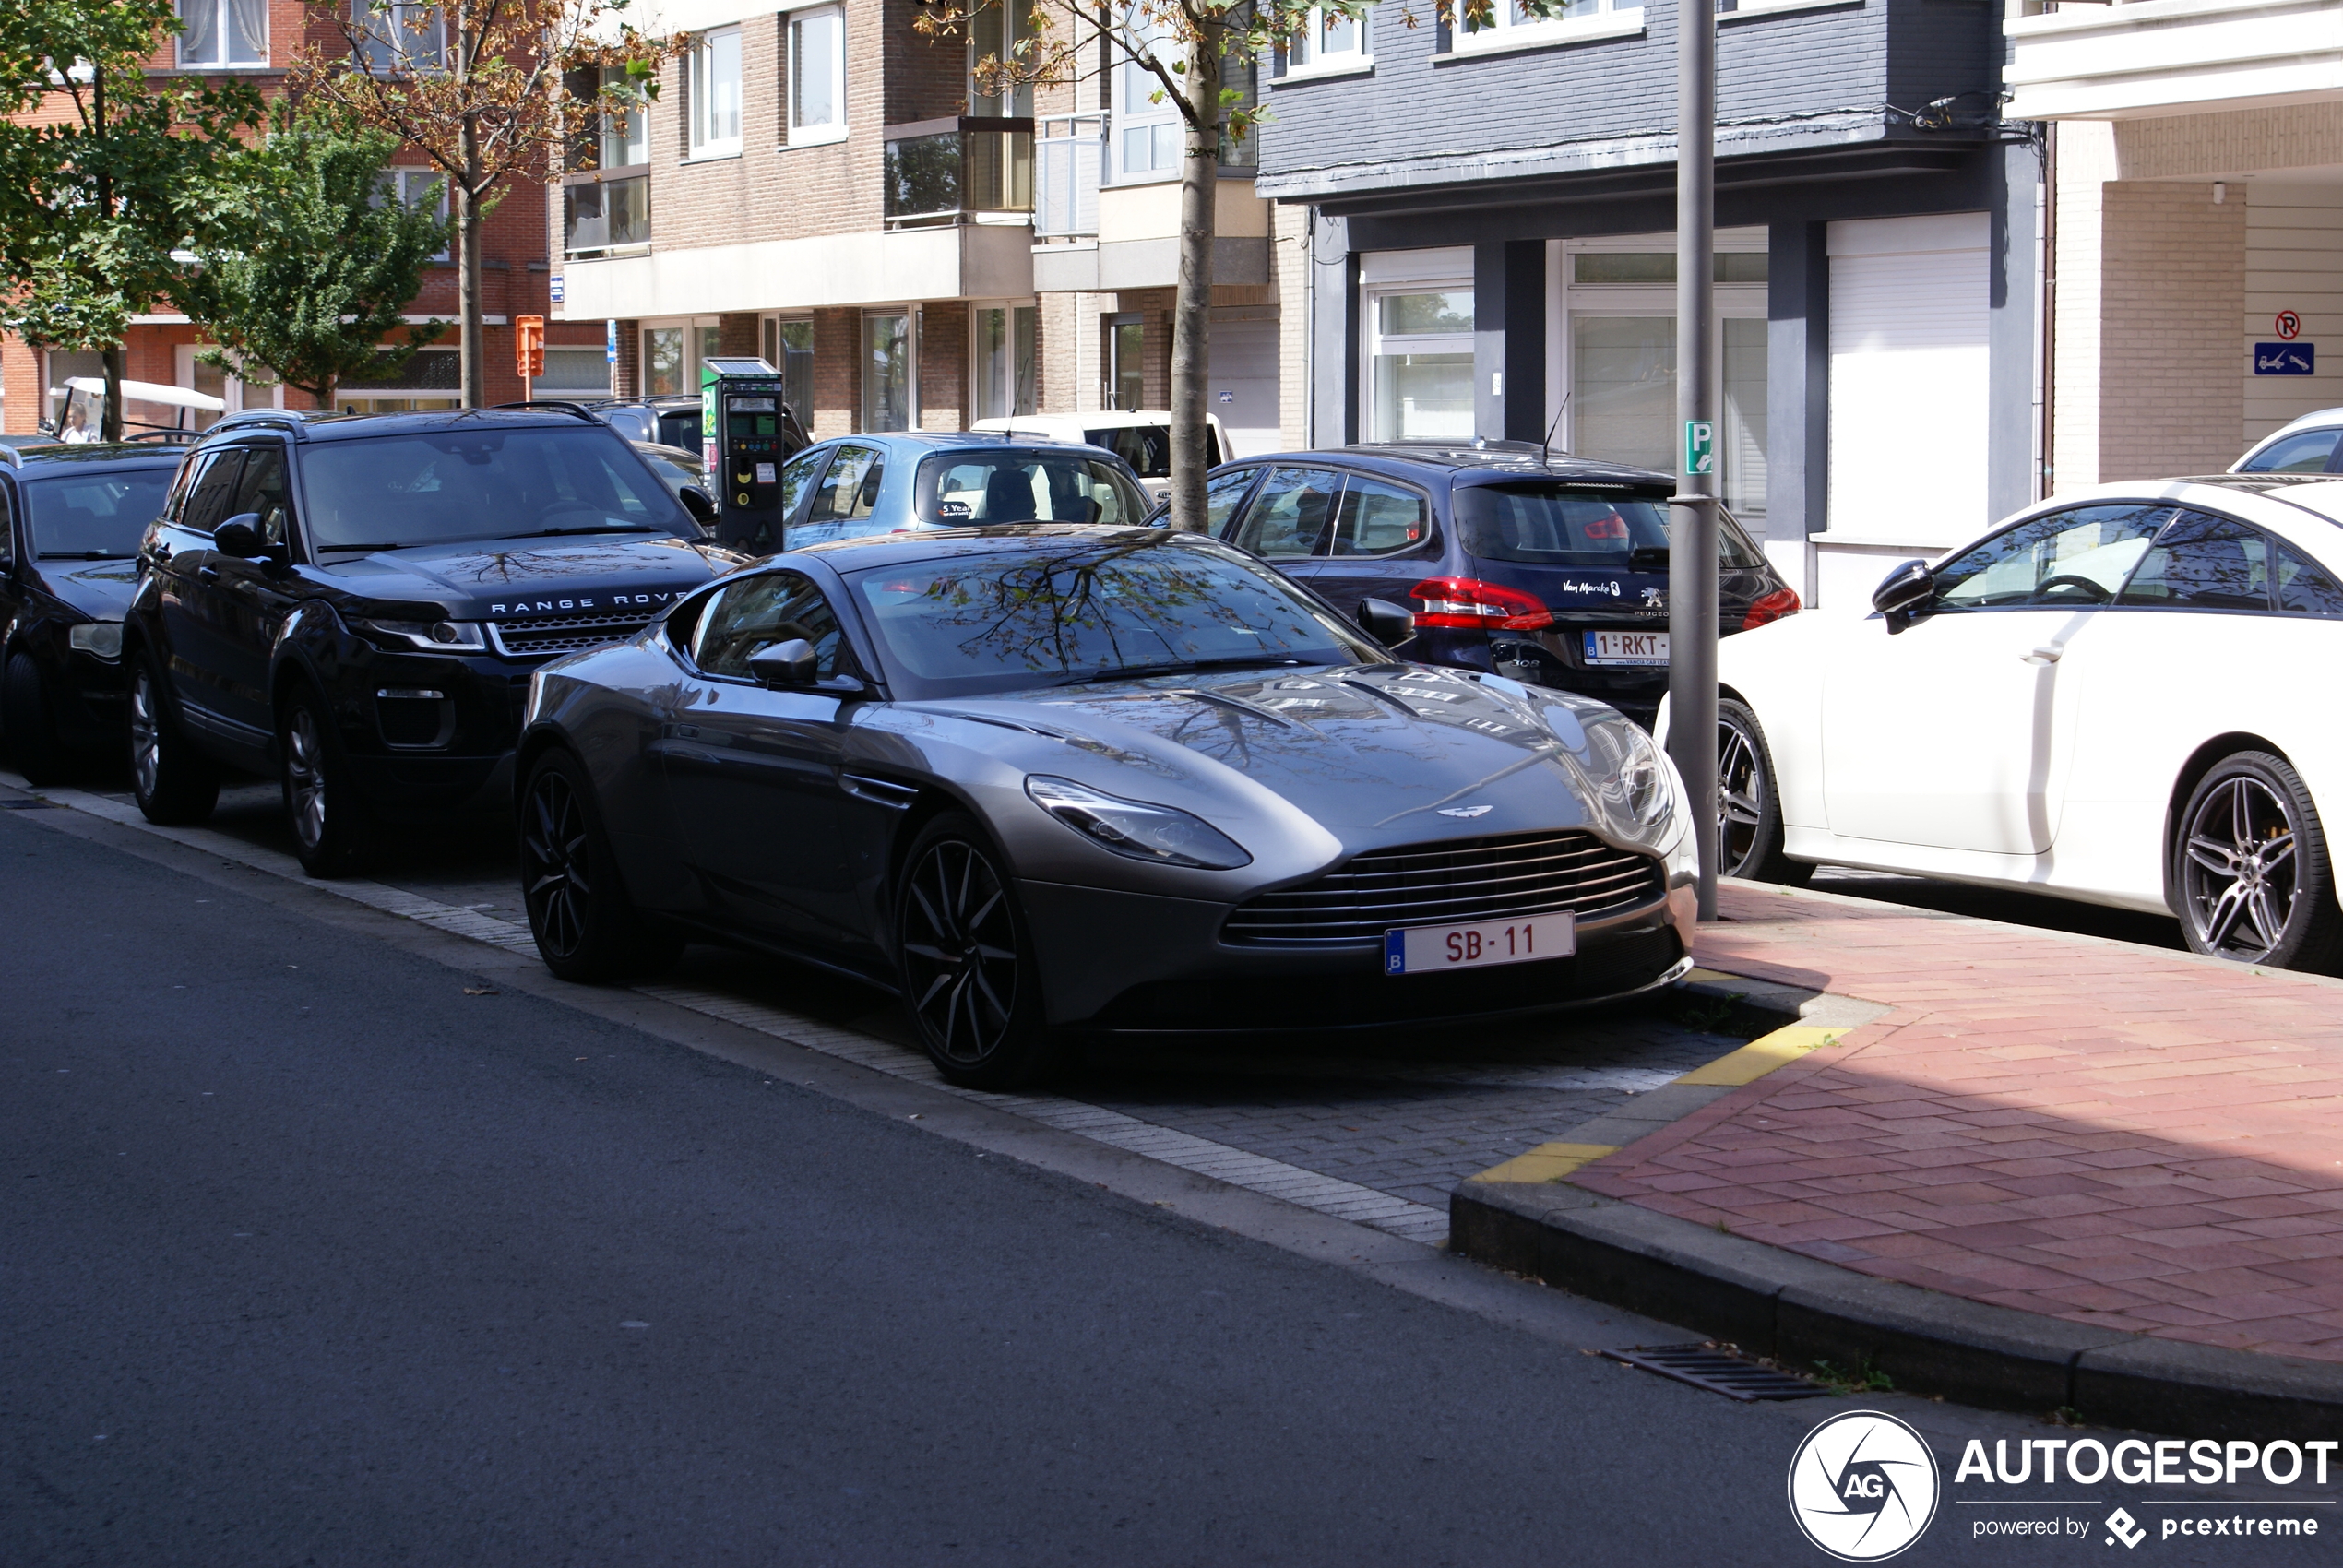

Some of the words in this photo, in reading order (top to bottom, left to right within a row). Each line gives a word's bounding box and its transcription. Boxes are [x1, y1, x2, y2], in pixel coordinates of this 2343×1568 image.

[2283, 316, 2296, 335] P
[1694, 423, 1711, 451] P
[1563, 579, 1578, 594] Van
[1579, 582, 1611, 595] Marcke
[491, 598, 594, 613] RANGE
[613, 591, 688, 605] ROVE
[1588, 646, 1596, 656] B
[1600, 635, 1667, 655] 1-RKT-
[1511, 659, 1540, 668] 308
[1446, 923, 1534, 962] SB-11
[1390, 954, 1402, 968] B
